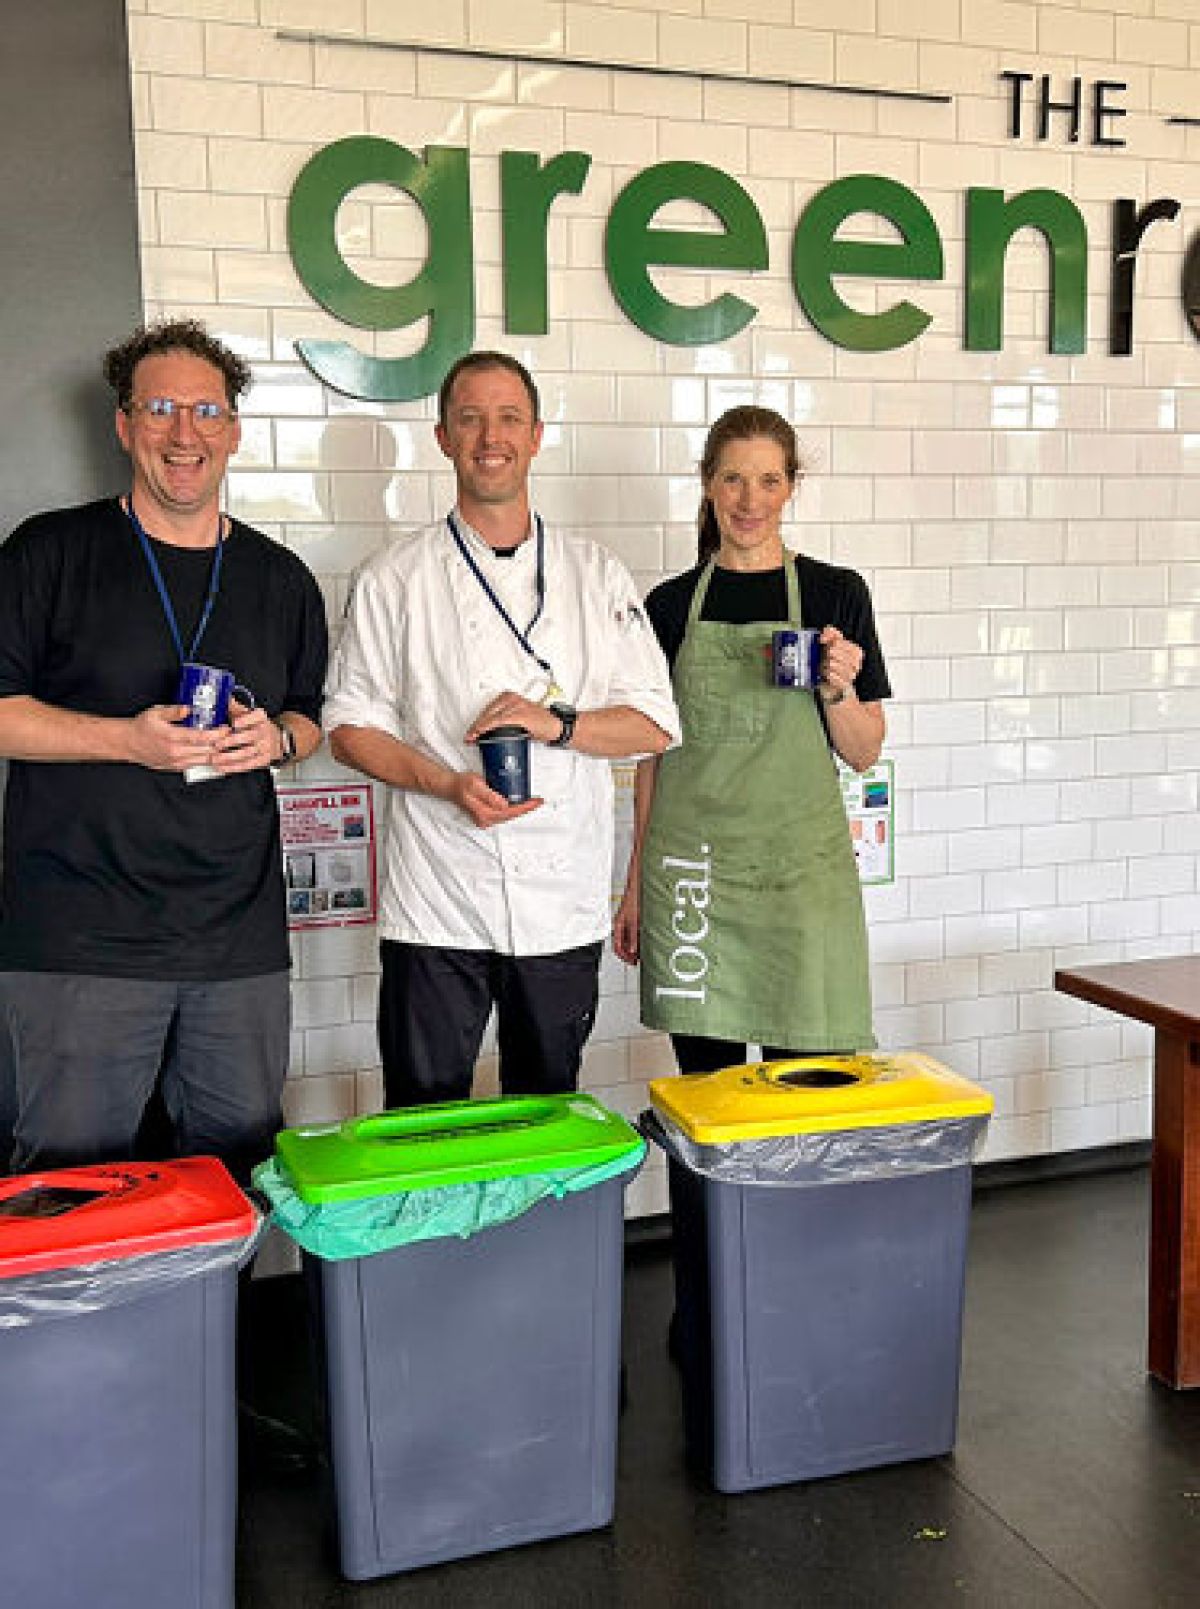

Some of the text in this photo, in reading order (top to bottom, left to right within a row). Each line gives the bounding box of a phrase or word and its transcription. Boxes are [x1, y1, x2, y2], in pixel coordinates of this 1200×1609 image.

[999, 70, 1127, 146] THE
[288, 135, 1200, 402] greenr
[655, 843, 712, 1005] local.
